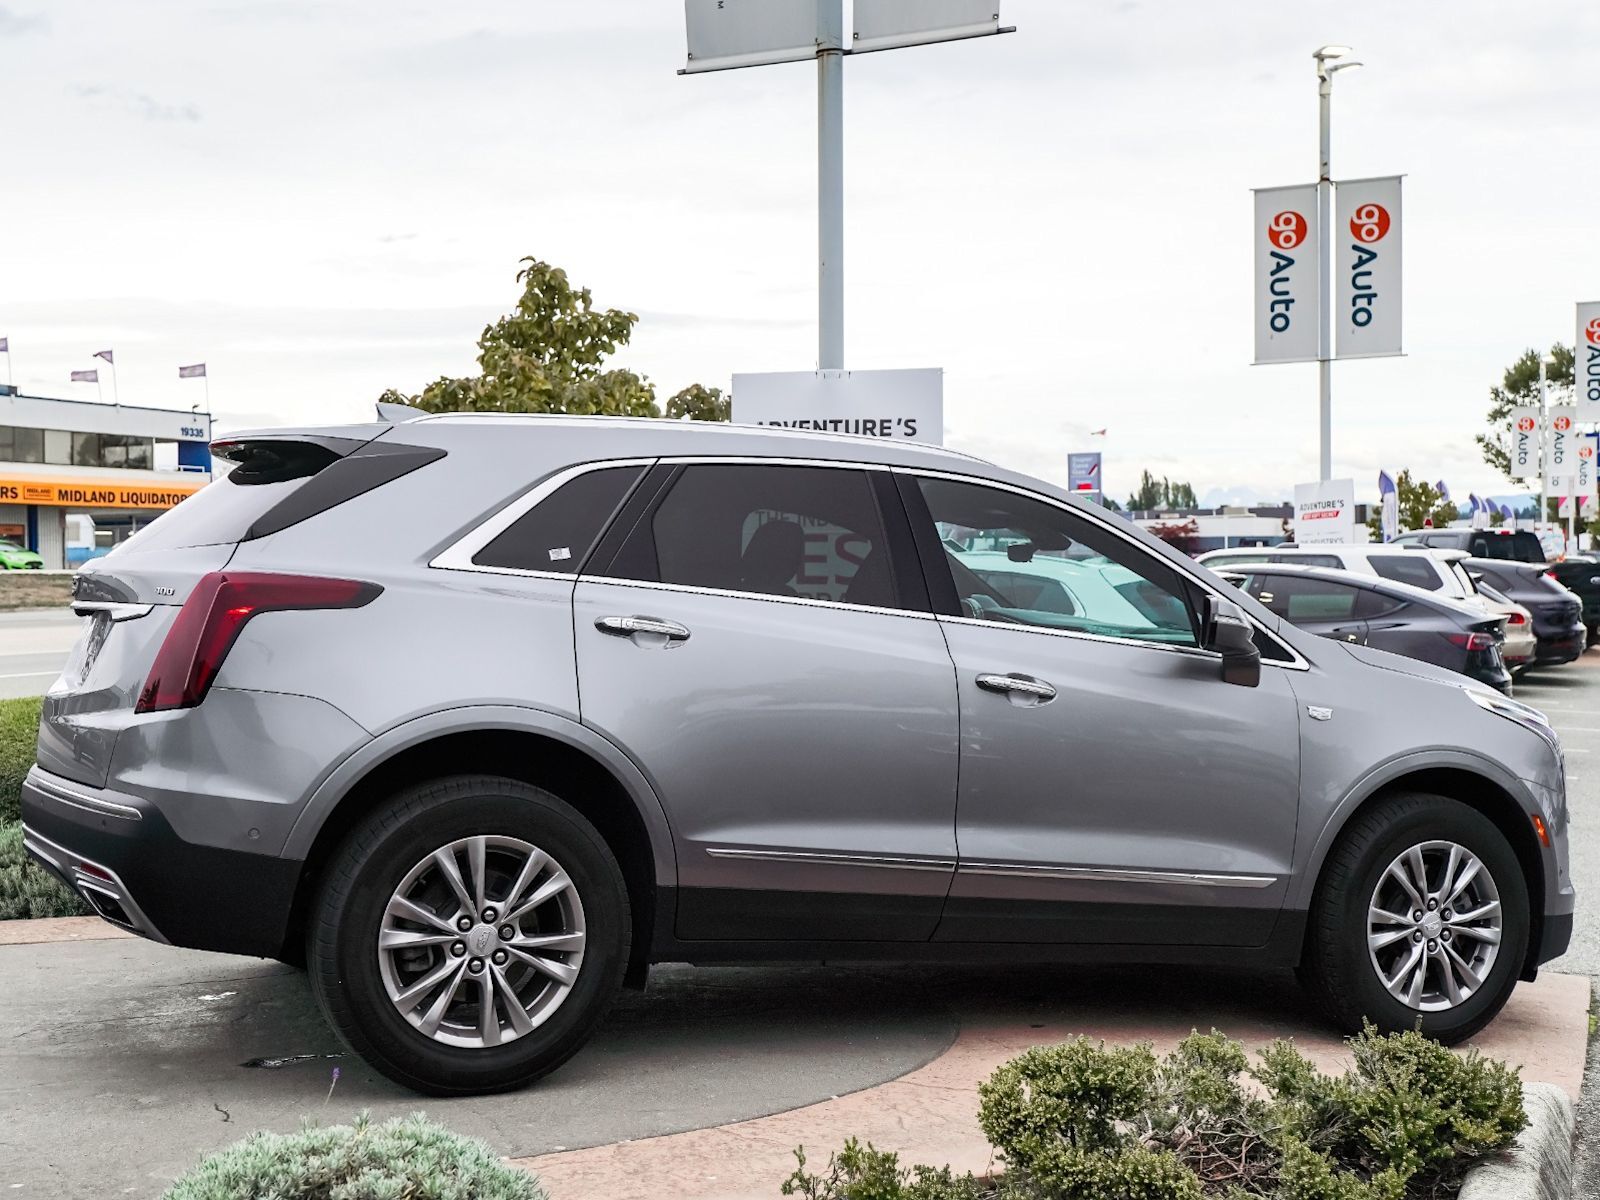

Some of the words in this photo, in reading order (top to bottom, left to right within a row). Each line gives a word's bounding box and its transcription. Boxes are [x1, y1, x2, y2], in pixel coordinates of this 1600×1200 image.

[1269, 211, 1298, 249] go
[1351, 204, 1380, 242] go
[1270, 251, 1295, 333] Auto
[1351, 244, 1378, 327] Auto
[180, 427, 204, 438] 19335
[757, 418, 917, 437] ENTURE'S
[1518, 432, 1528, 465] Auto
[1554, 431, 1565, 465] Auto
[1579, 459, 1588, 486] Auto
[58, 489, 116, 503] MIDLAND
[120, 491, 190, 505] LIQUIDATOR
[1300, 499, 1344, 511] ADVENTURE'S
